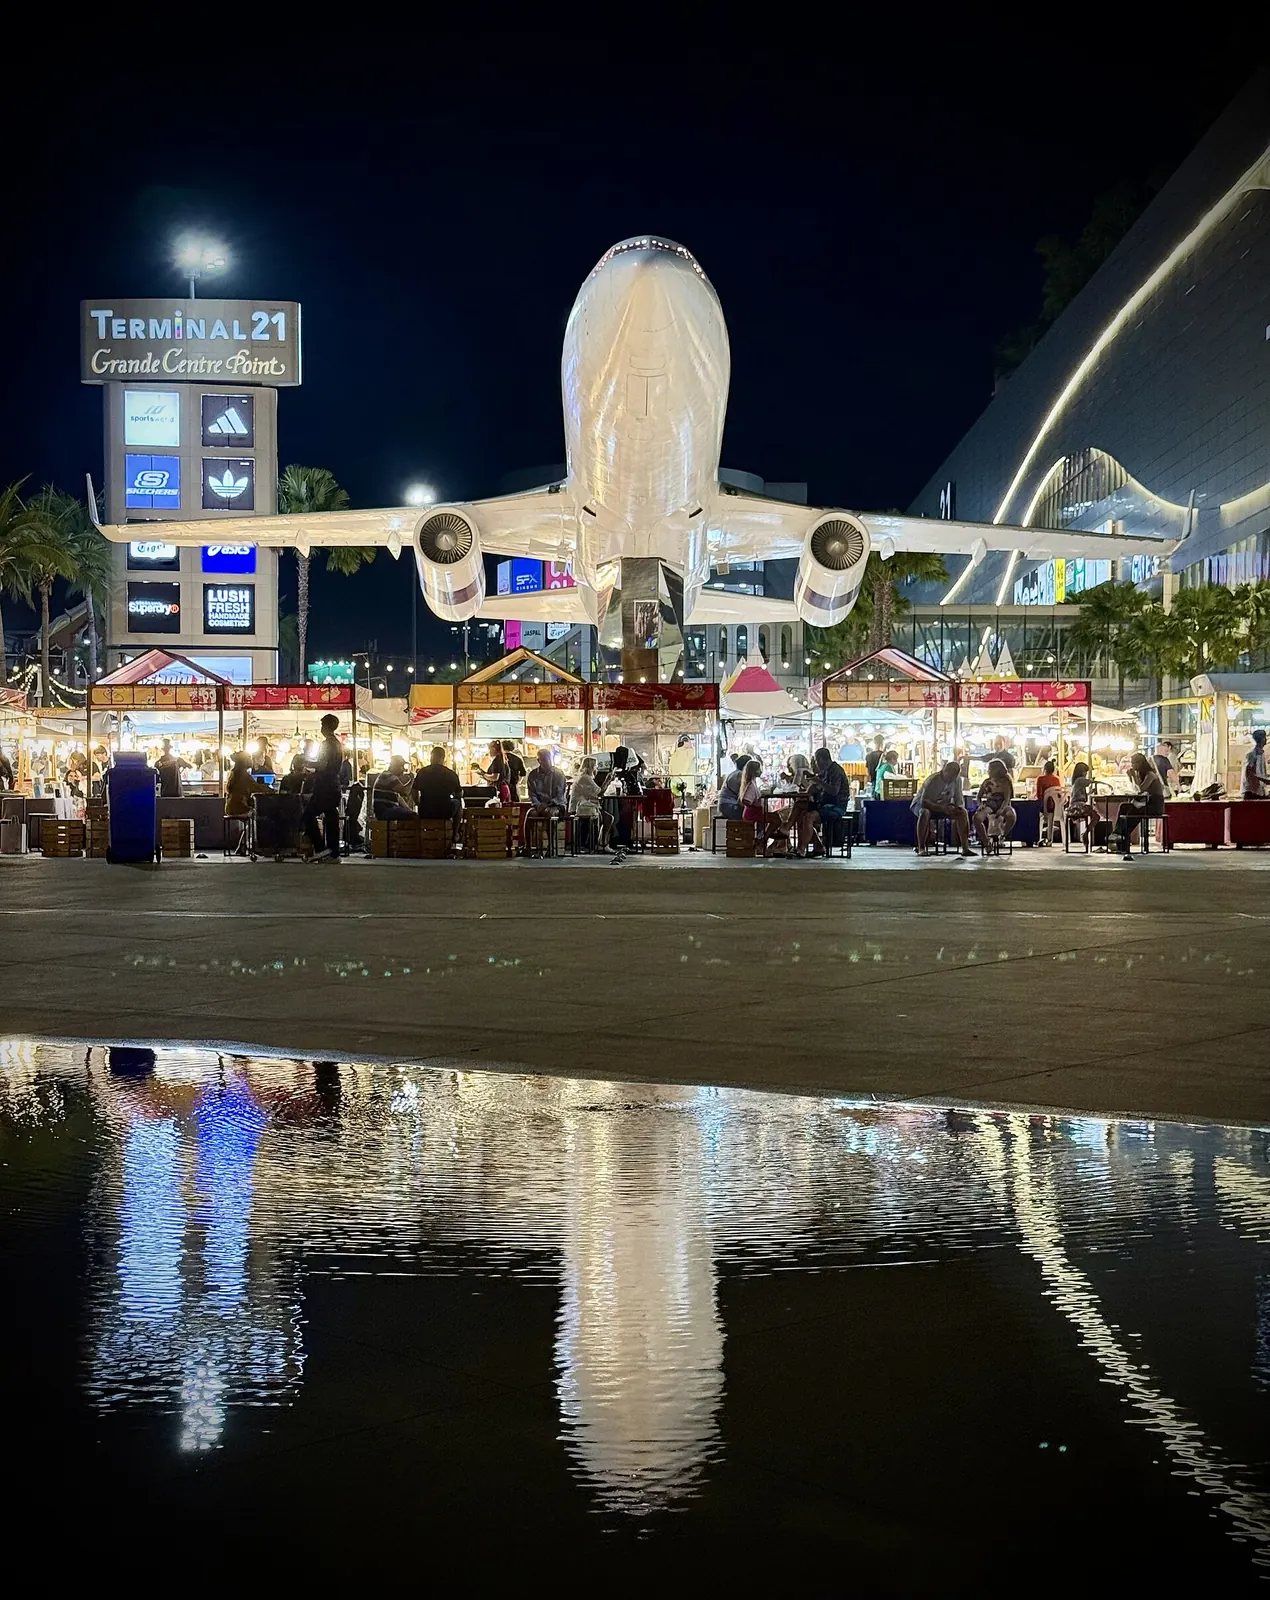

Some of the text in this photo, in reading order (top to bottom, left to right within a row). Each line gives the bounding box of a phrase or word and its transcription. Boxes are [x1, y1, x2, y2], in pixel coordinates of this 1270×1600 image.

[91, 347, 286, 376] Grande Centre Point
[126, 488, 179, 496] SKECHERS
[516, 574, 538, 585] SFX
[208, 589, 250, 602] LUSH
[208, 602, 250, 613] FRESH
[208, 619, 251, 627] COSMETICS
[524, 629, 541, 637] JASPAL
